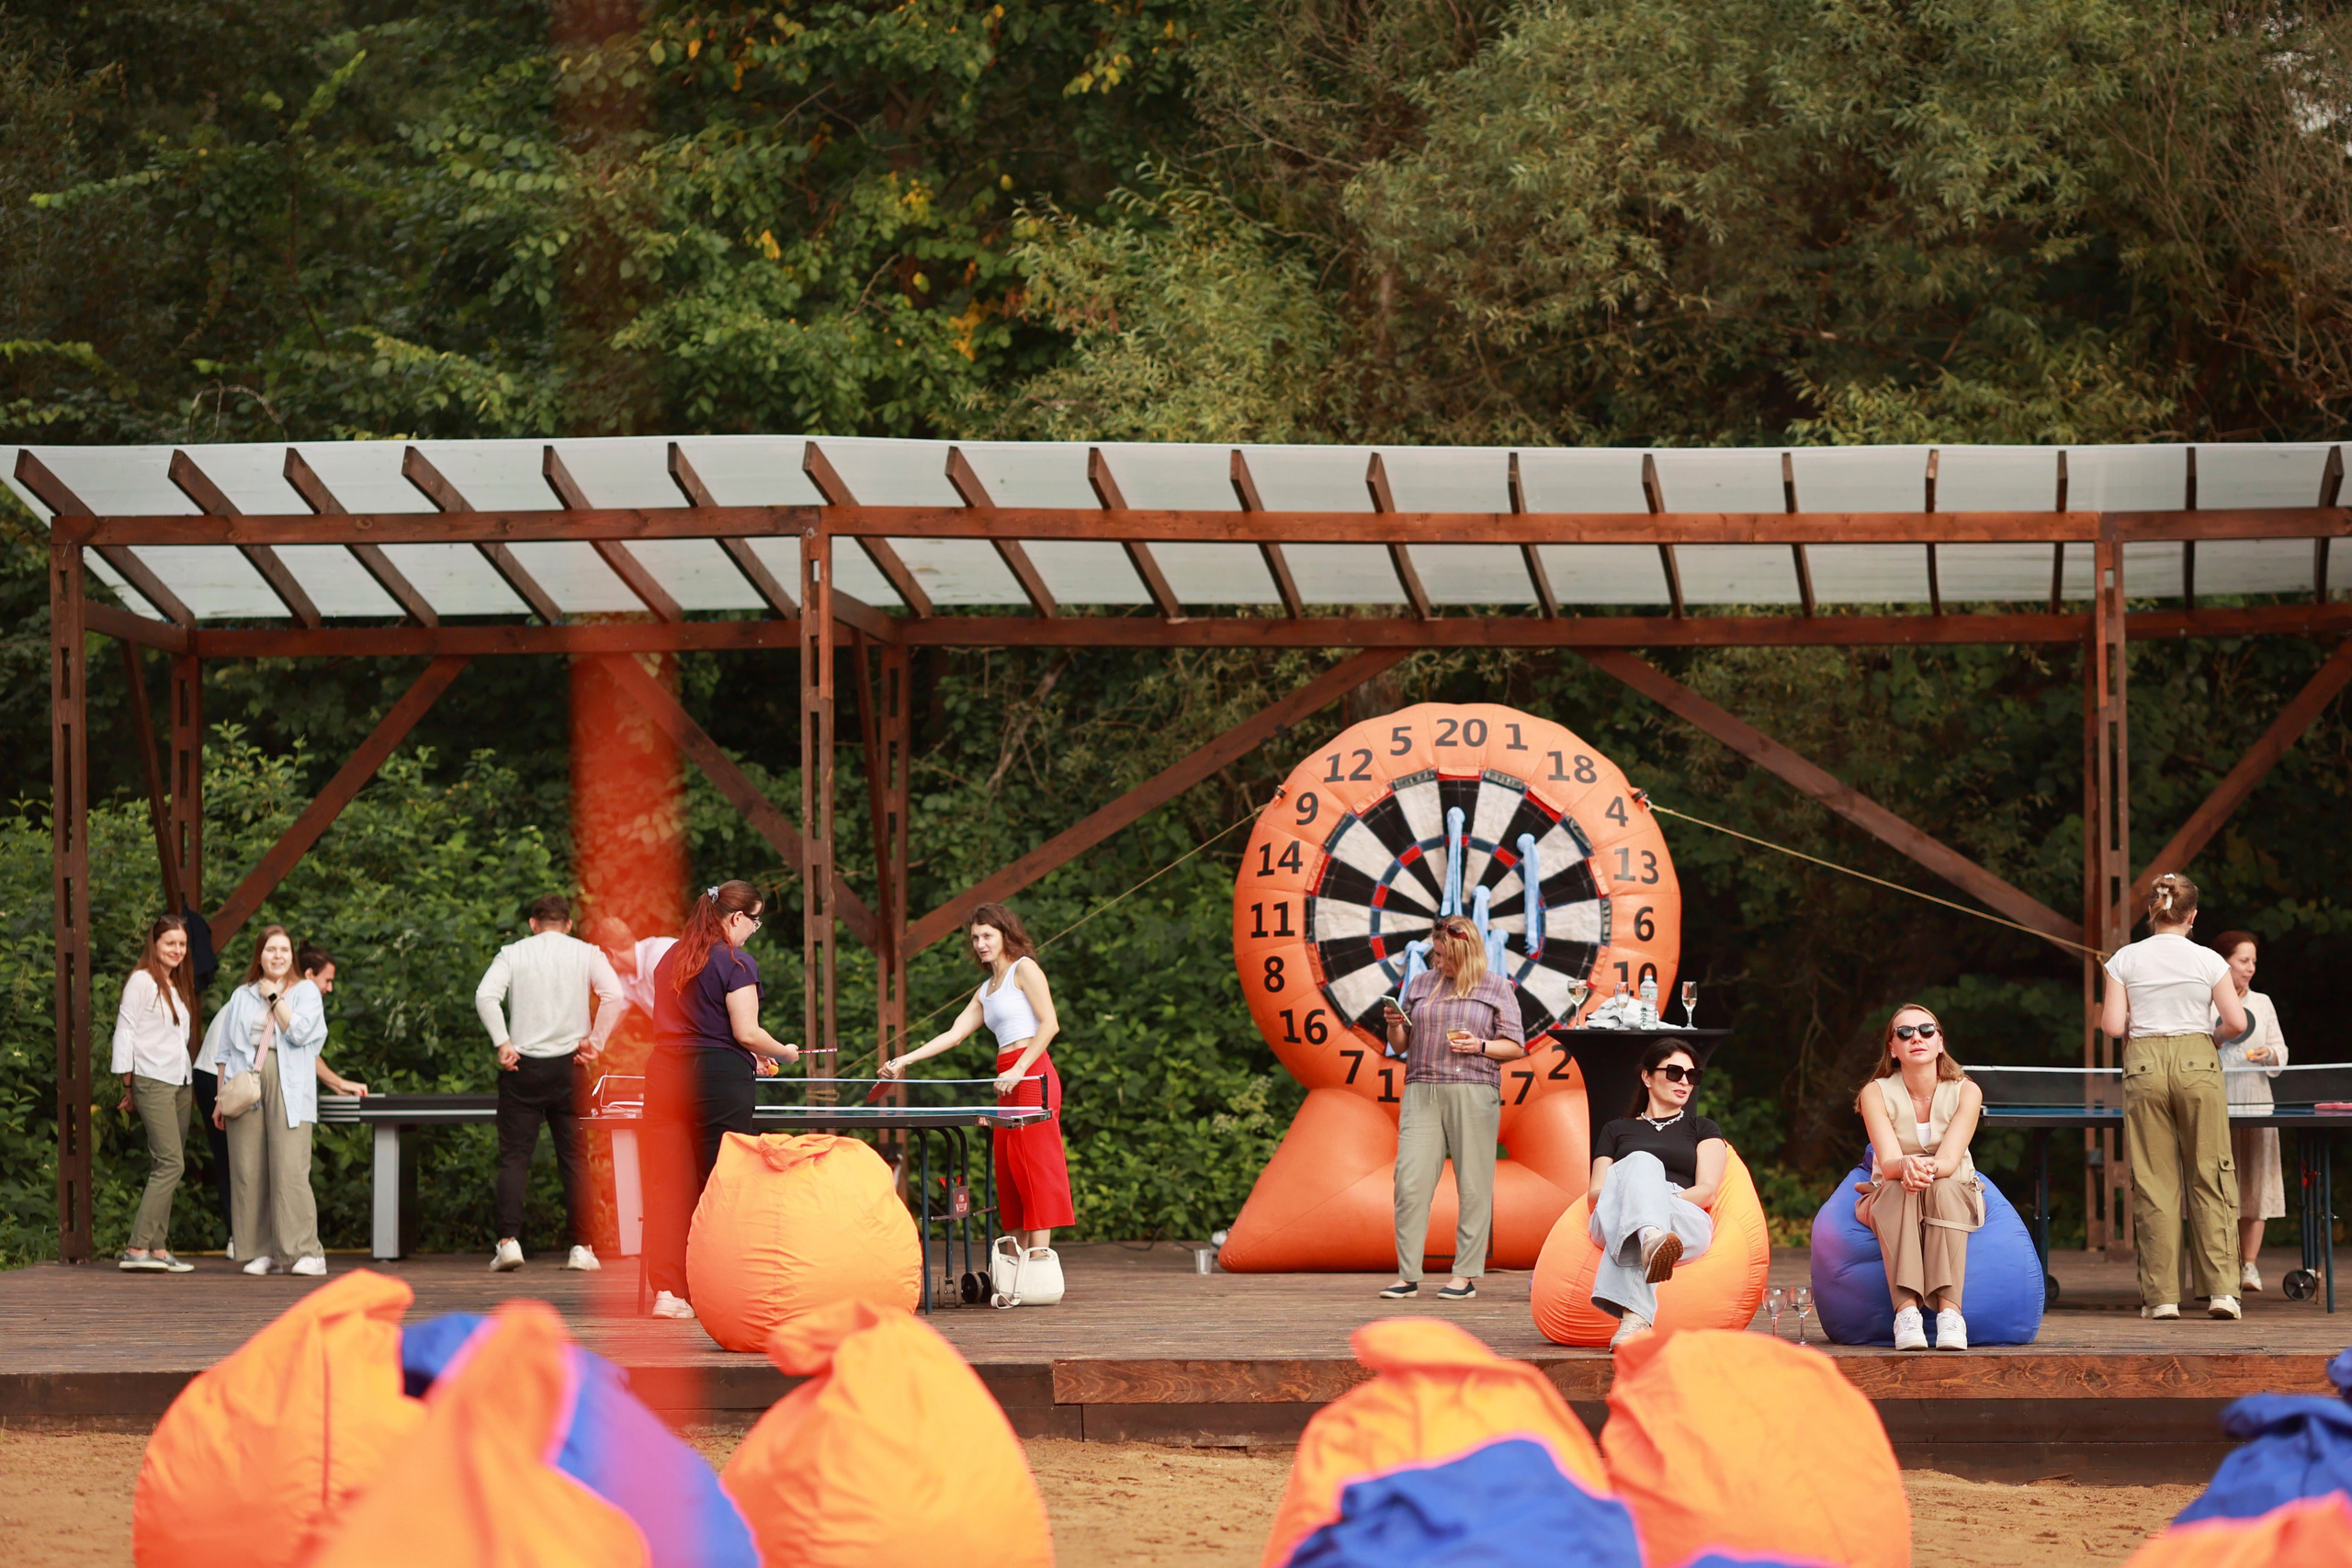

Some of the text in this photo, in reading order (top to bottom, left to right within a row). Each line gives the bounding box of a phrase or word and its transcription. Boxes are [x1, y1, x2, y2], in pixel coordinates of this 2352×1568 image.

[1389, 726, 1413, 756] 5
[1435, 718, 1488, 747] 20
[1505, 724, 1529, 751] 1
[1323, 749, 1374, 783] 12
[1547, 750, 1598, 784] 18
[1295, 792, 1319, 826] 9
[1605, 796, 1629, 828] 4
[1256, 840, 1304, 877] 14
[1613, 847, 1659, 885] 13
[1250, 901, 1295, 939] 11
[1634, 907, 1655, 942] 6
[1263, 956, 1285, 993] 8
[1279, 1009, 1329, 1045] 16
[1340, 1050, 1365, 1085] 7
